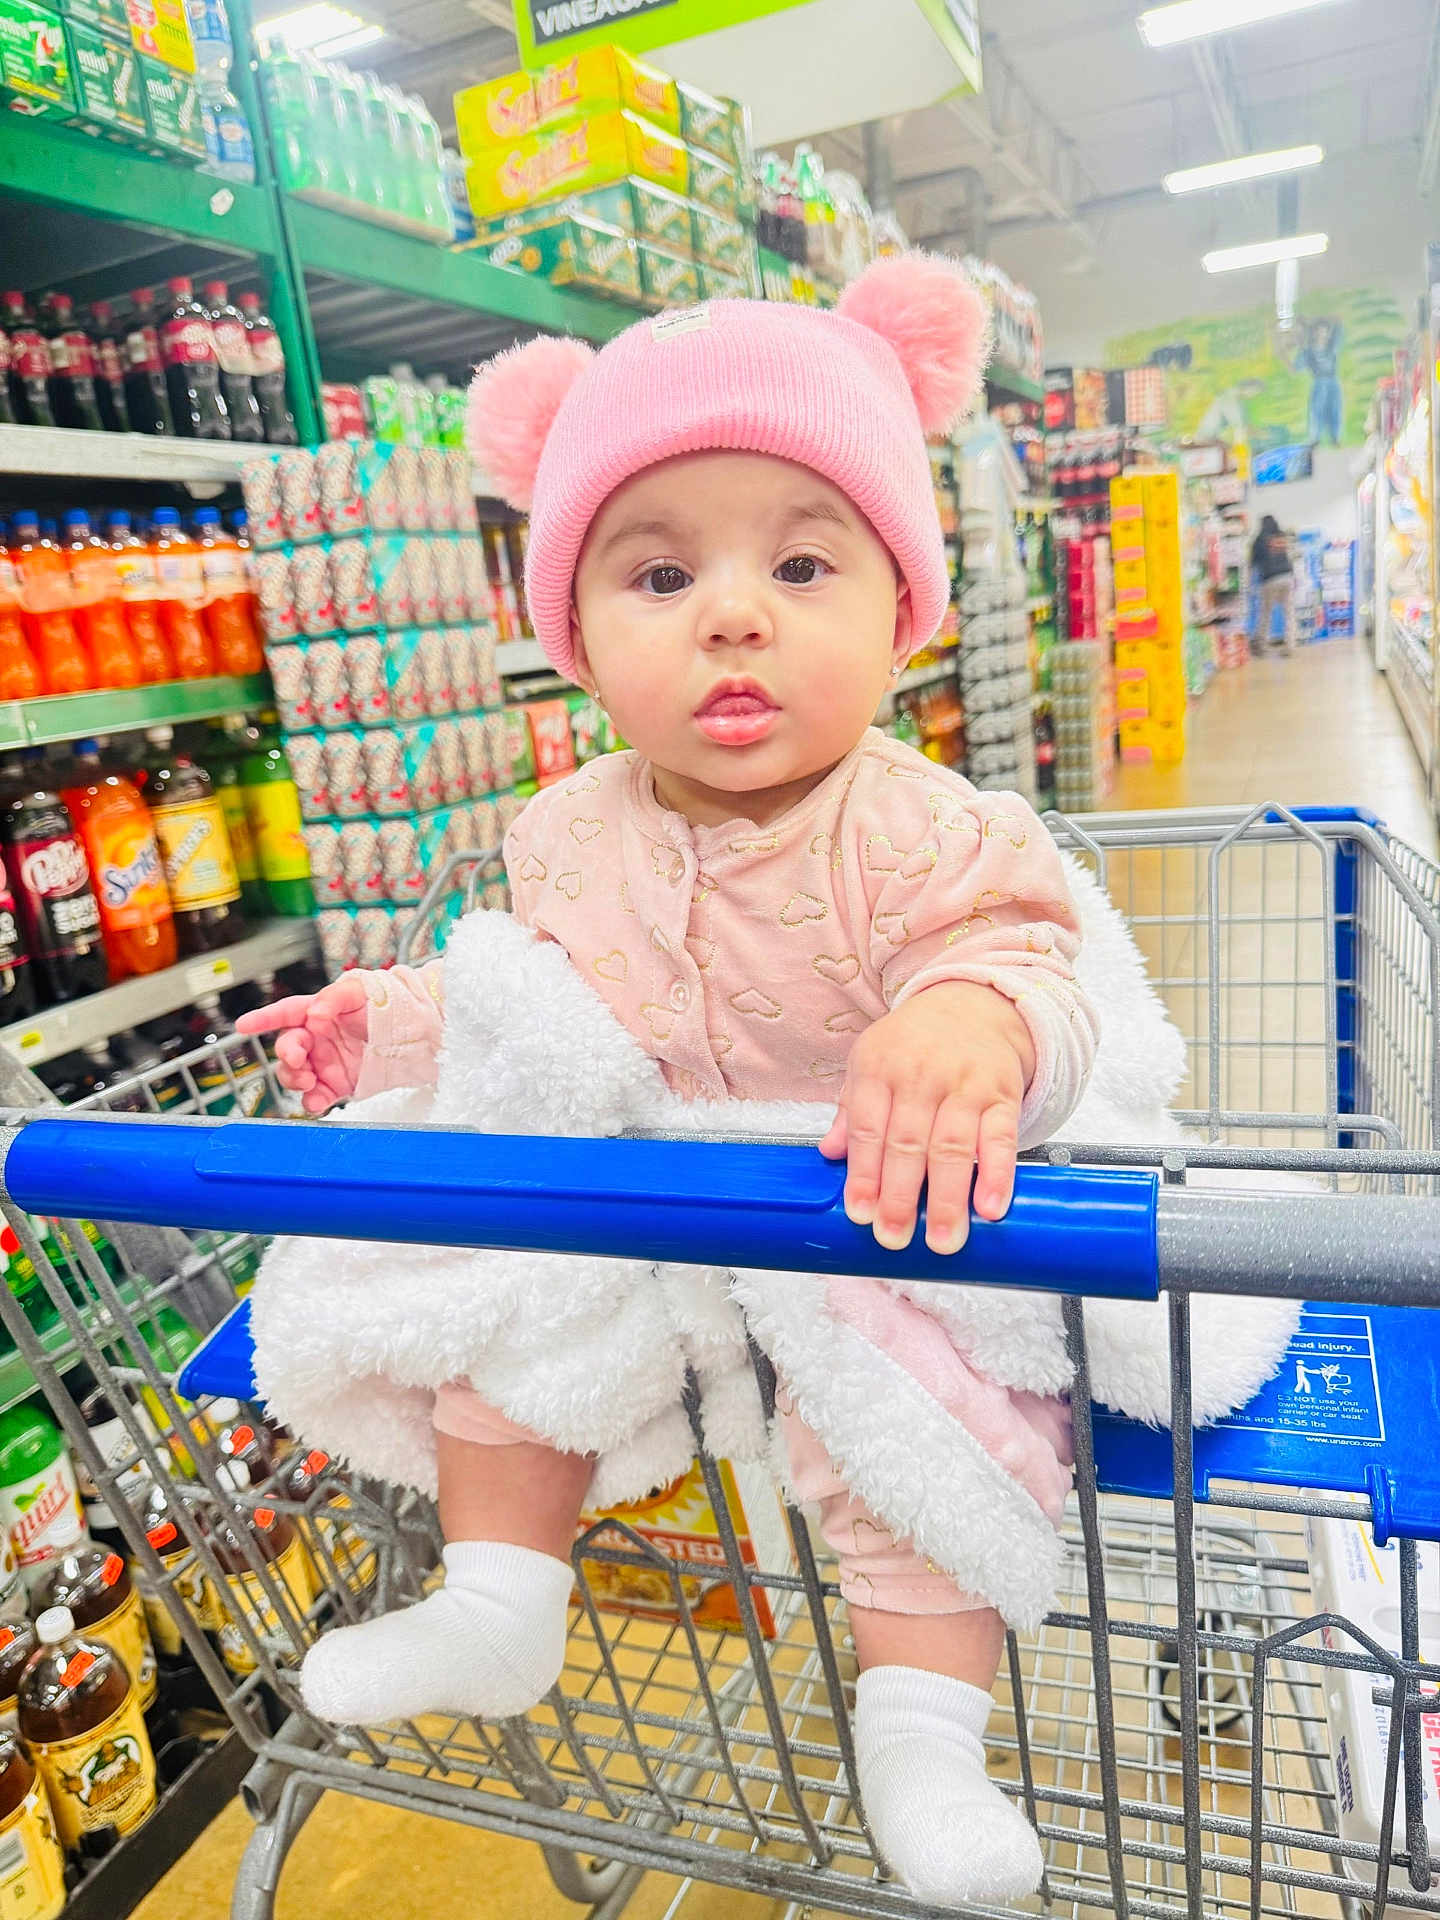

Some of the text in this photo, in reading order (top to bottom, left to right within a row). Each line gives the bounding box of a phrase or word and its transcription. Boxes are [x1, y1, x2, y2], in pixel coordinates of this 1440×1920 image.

[1293, 1395, 1315, 1403] NOT
[1278, 1418, 1308, 1427] 15-35
[1306, 1436, 1383, 1448] www.unarco.com
